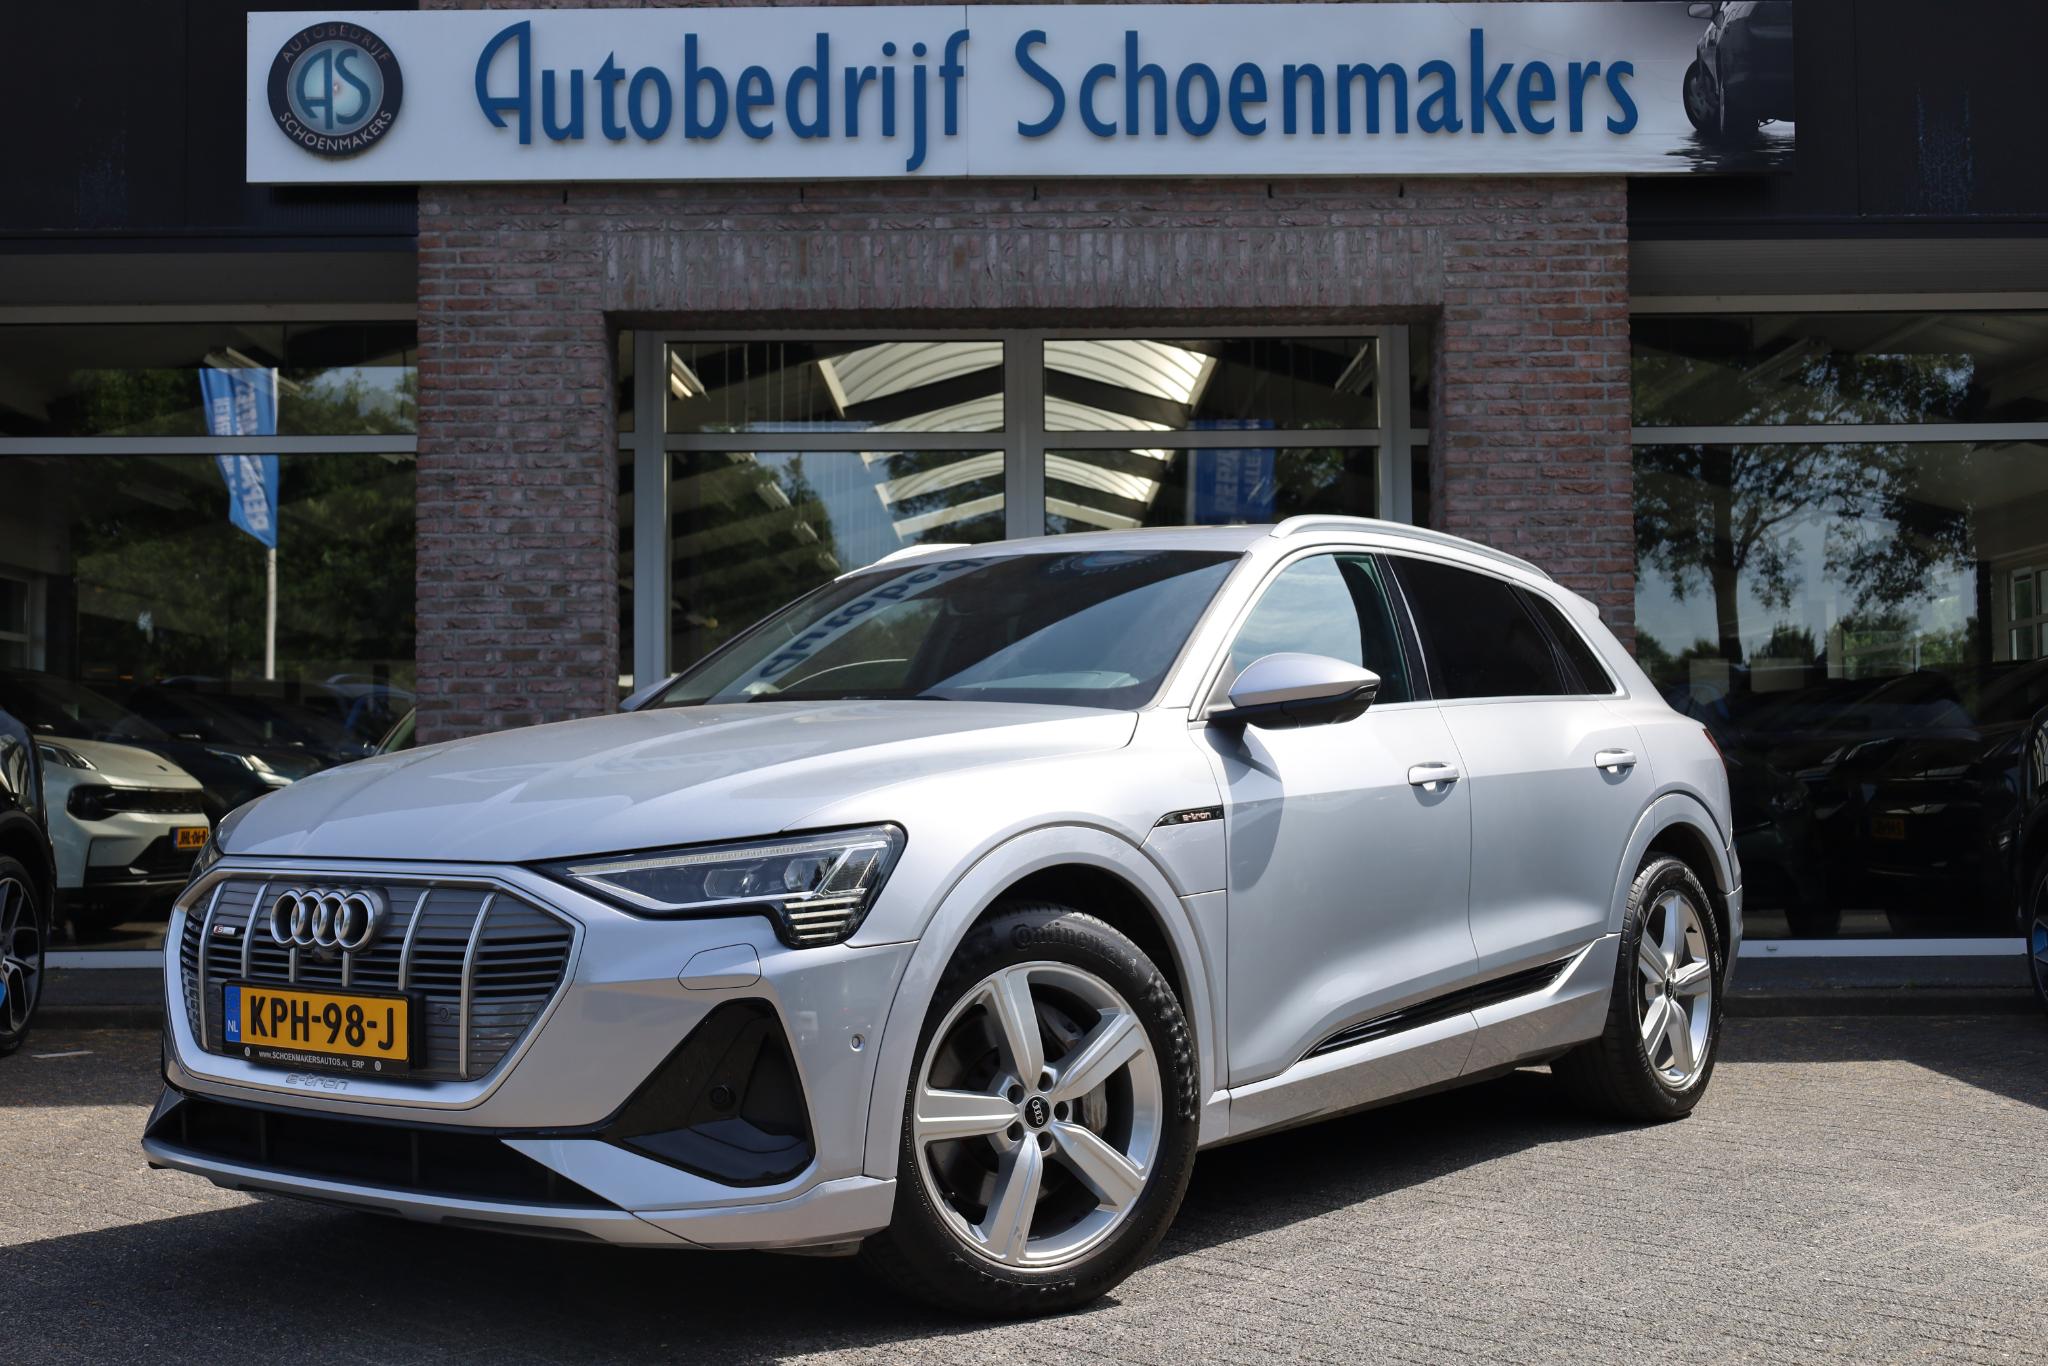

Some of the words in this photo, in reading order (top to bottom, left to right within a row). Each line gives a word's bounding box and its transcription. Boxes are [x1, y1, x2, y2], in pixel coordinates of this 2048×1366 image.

[296, 48, 371, 130] AS
[475, 20, 969, 172] Autobedrijf
[1013, 27, 1639, 138] Schoenmakers
[279, 110, 392, 151] SCHOENMAKERS
[1182, 811, 1212, 822] e-tron
[227, 1020, 239, 1034] NL
[250, 995, 395, 1051] KPH-98-J
[351, 1060, 365, 1069] ERP
